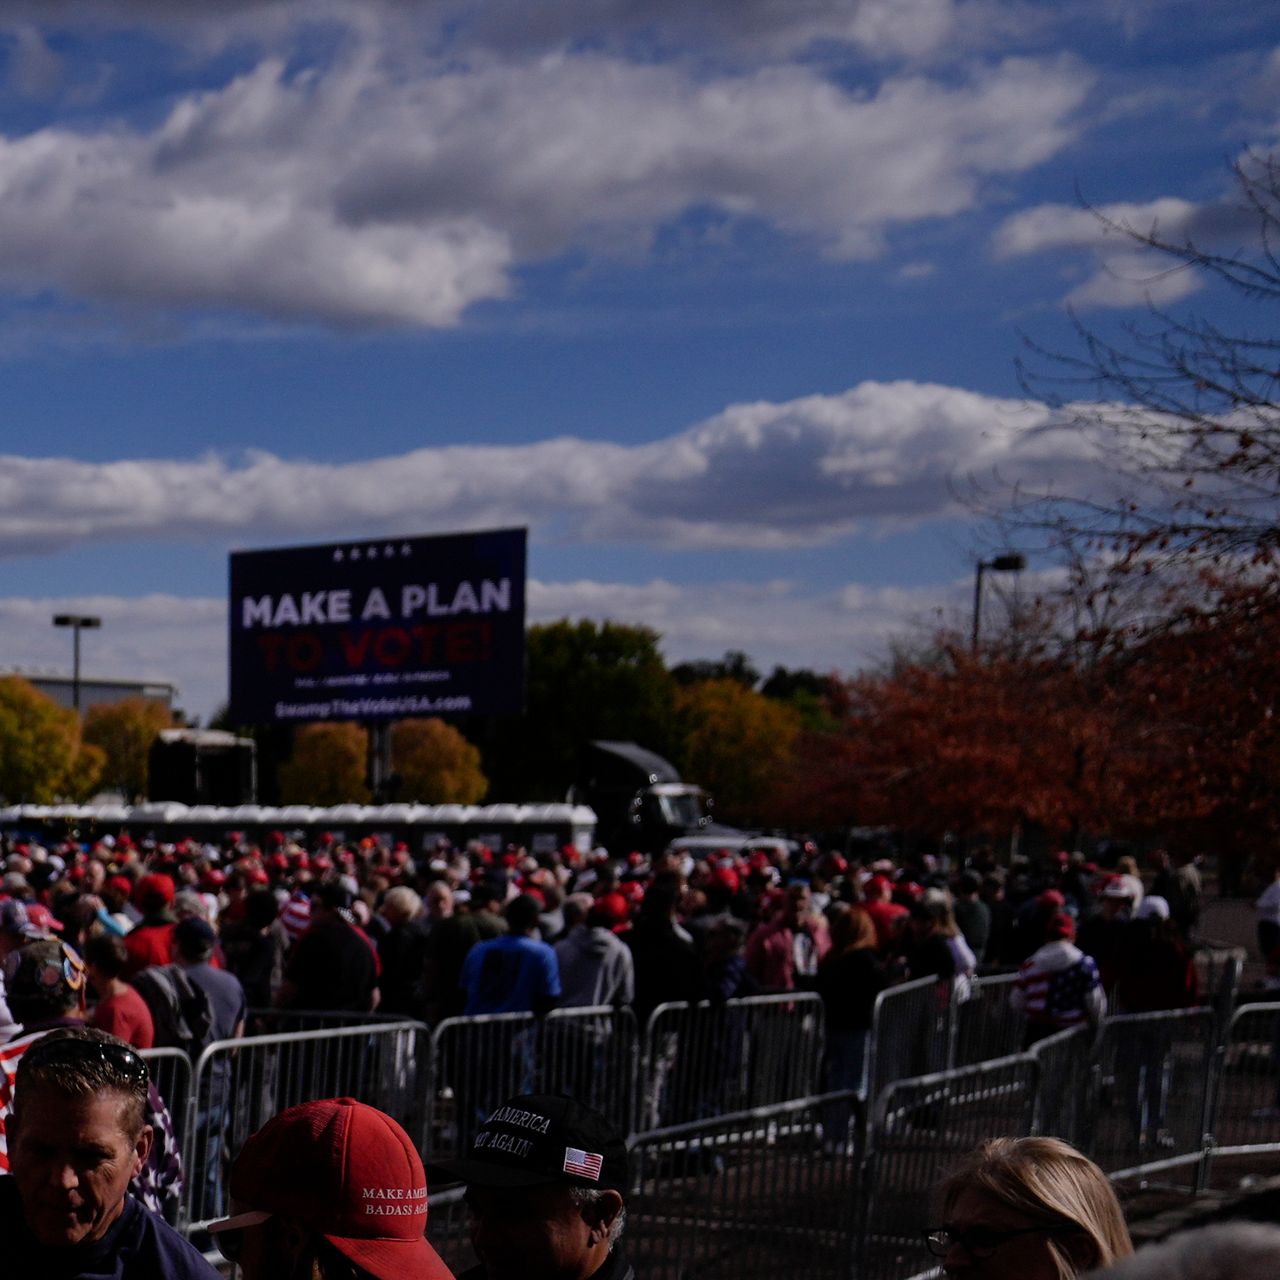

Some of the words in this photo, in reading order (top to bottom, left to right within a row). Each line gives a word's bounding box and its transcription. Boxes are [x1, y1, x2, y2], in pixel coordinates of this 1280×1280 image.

[243, 589, 352, 628] MAKE
[361, 587, 390, 621] A
[401, 577, 511, 618] PLAN
[256, 632, 322, 672] TO
[342, 620, 494, 669] VOTE!
[493, 1106, 552, 1135] AMERICA
[488, 1132, 534, 1159] AGAIN
[363, 1187, 403, 1200] MAKE
[366, 1204, 412, 1216] BADASS
